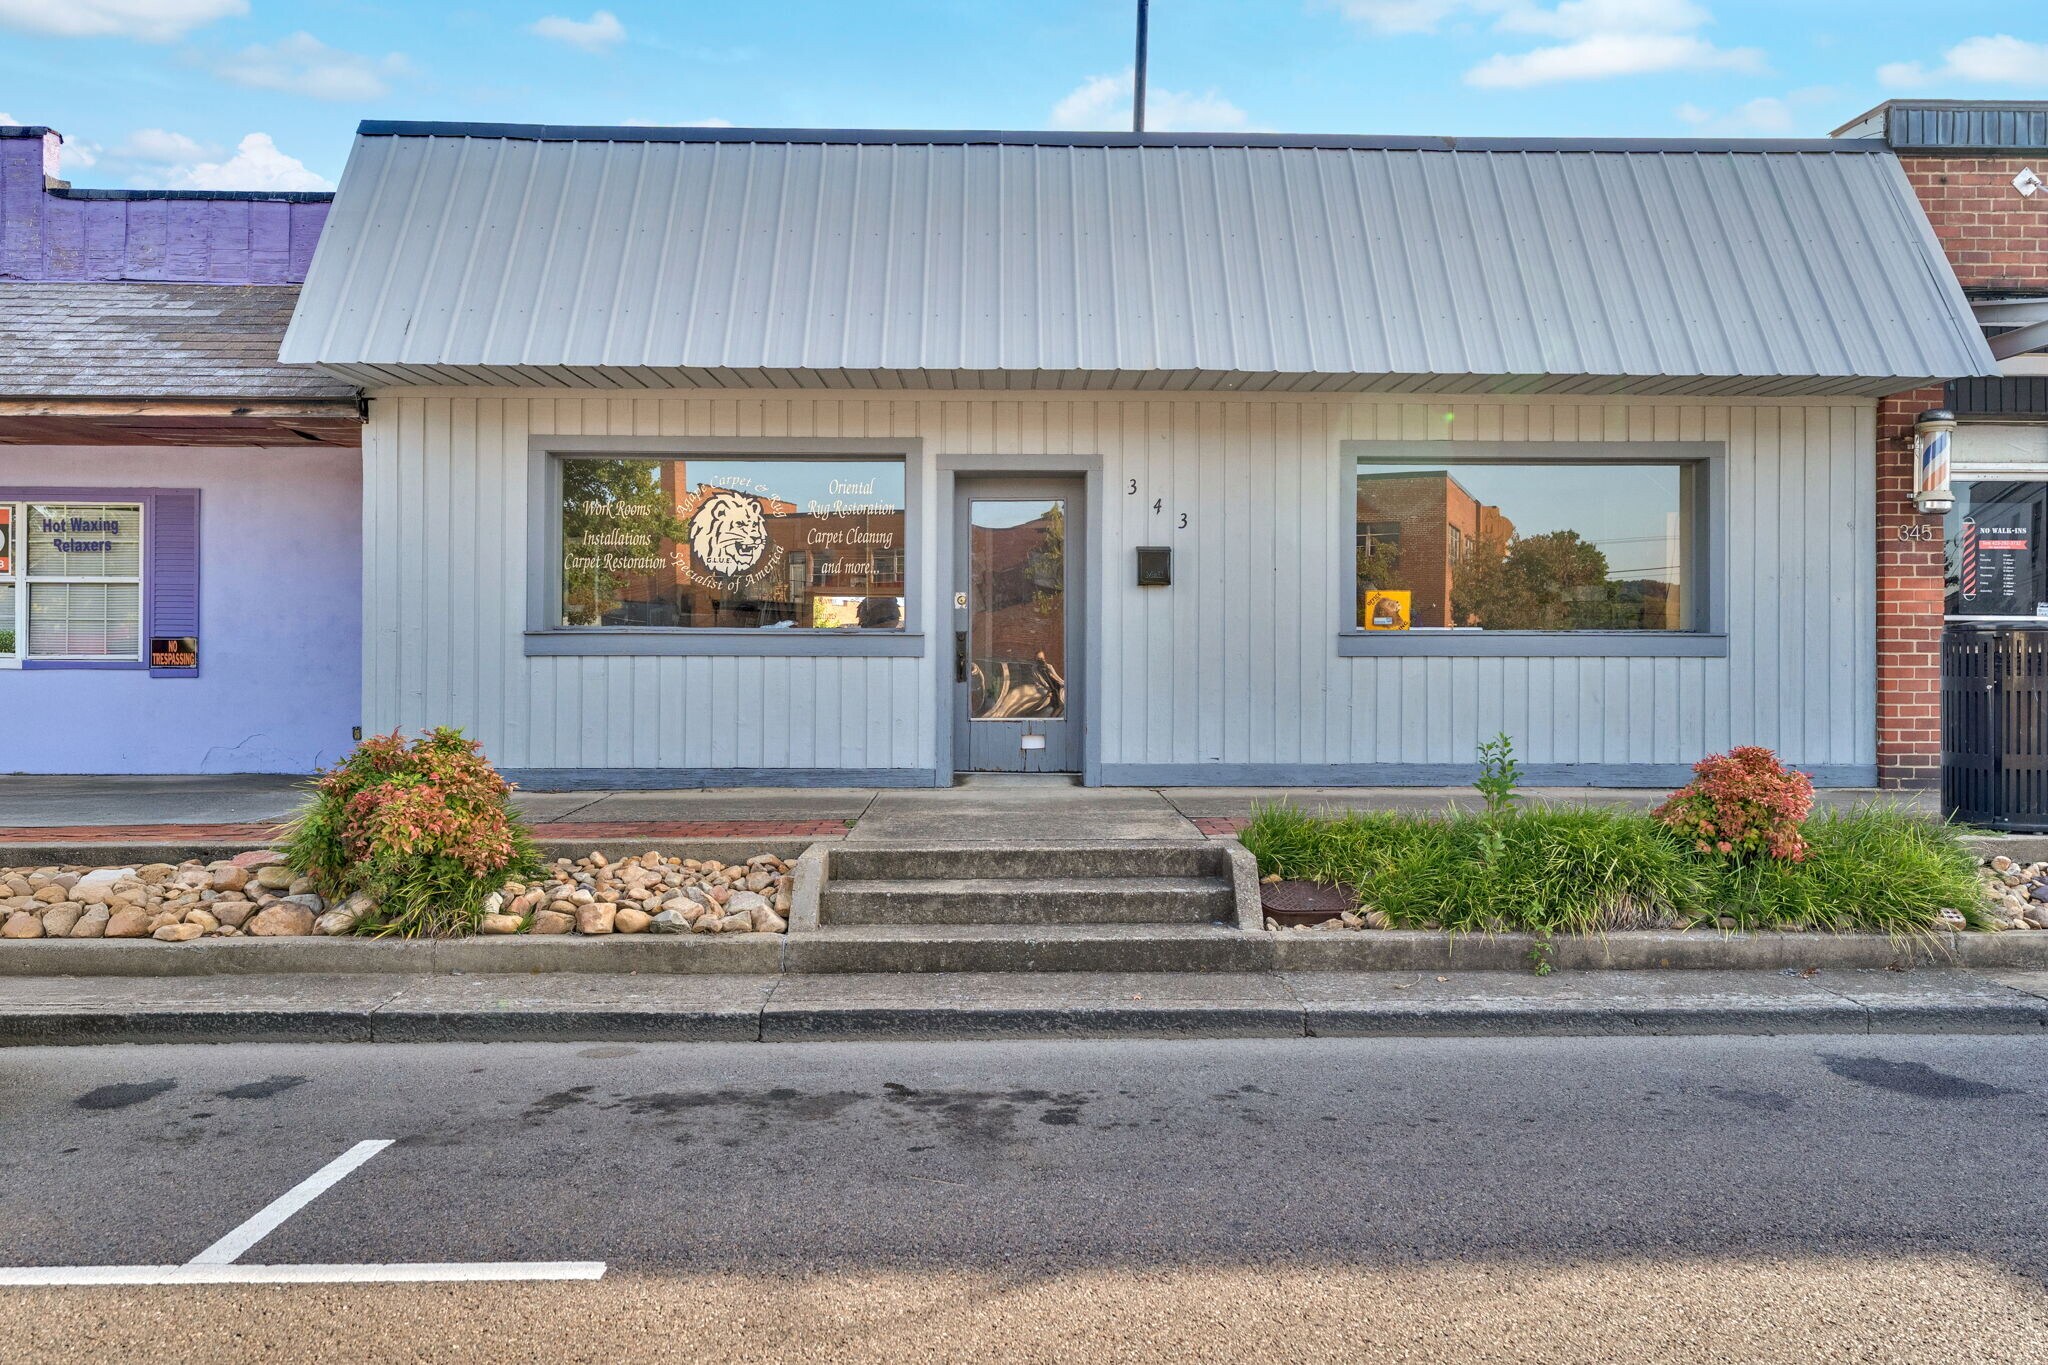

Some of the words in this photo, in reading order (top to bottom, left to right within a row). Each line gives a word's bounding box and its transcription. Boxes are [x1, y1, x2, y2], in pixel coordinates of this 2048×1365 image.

[828, 477, 876, 495] Oriental
[676, 484, 708, 517] Agape
[710, 475, 752, 489] Carpet
[768, 492, 787, 518] Rug
[582, 499, 615, 519] Work
[615, 500, 651, 519] Rooms
[807, 500, 830, 521] Rug
[832, 499, 896, 519] Restoration
[42, 518, 66, 533] Hot
[70, 517, 118, 535] Waxing
[1898, 524, 1933, 541] 345
[53, 538, 112, 552] Relaxers
[582, 528, 651, 552] Installations
[807, 527, 844, 549] Carpet
[845, 526, 894, 549] Cleaning
[564, 553, 601, 574] Carpet
[603, 553, 667, 572] Restoration
[670, 551, 724, 590] Specialist
[727, 576, 742, 594] of
[745, 544, 785, 587] America
[821, 557, 844, 574] and
[168, 640, 178, 652] NO
[152, 652, 195, 665] TRESPASSING
